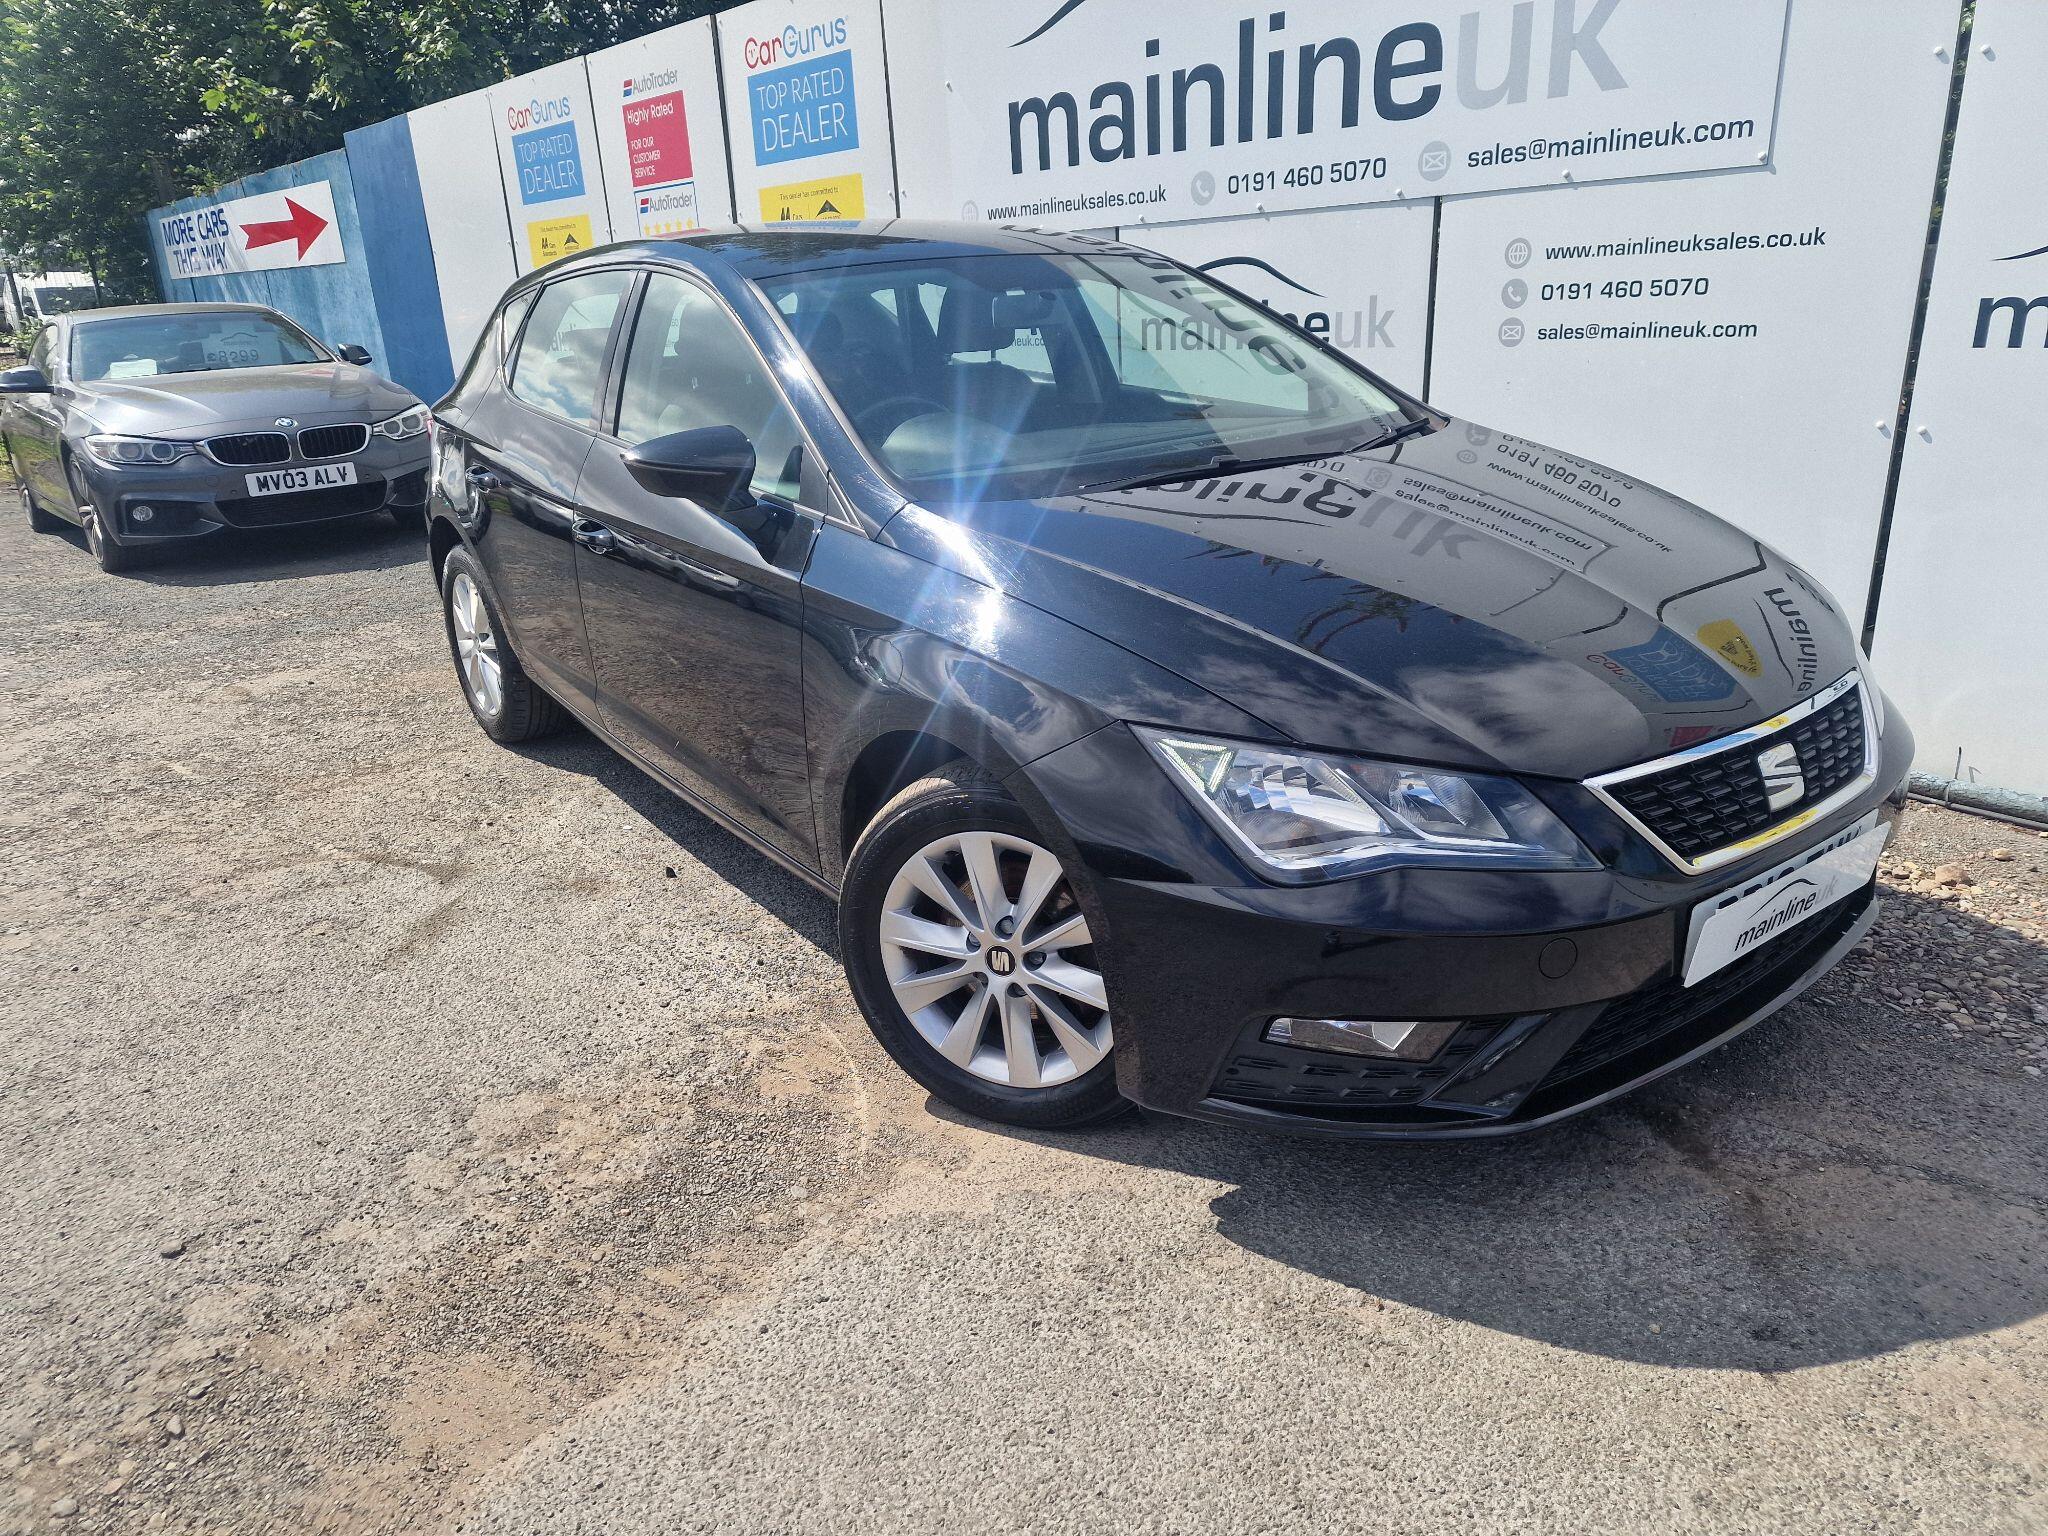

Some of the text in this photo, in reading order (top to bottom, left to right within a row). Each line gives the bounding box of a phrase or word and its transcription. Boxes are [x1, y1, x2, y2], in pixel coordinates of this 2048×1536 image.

[744, 17, 847, 69] CarGurus
[632, 68, 678, 95] AutoTrader
[756, 67, 844, 111] TOP RATED
[1008, 0, 1629, 174] mainlineuk
[508, 96, 570, 130] CarGurus
[627, 100, 674, 125] Highly Rated
[762, 102, 848, 151] DEALER
[518, 133, 573, 162] TOP RATED
[630, 136, 654, 150] FOR OUR
[633, 149, 661, 164] CUSTOMER
[1467, 119, 1754, 168] sales@mainlineuk.com
[524, 160, 578, 194] DEALER
[634, 165, 655, 178] SERVICE
[1228, 157, 1387, 194] 0191 460 5070
[649, 191, 693, 213] AutoTrader
[987, 184, 1167, 221] www.mainlineuksales.co.uk
[162, 208, 230, 247] MORE CARS
[200, 242, 229, 271] WAY
[1545, 227, 1827, 259] www.mainlineuksales.co.uk
[1541, 277, 1710, 301] 0191 460 5070
[1537, 320, 1758, 340] sales@mainlineuk.com
[256, 465, 347, 492] MV03 ALV
